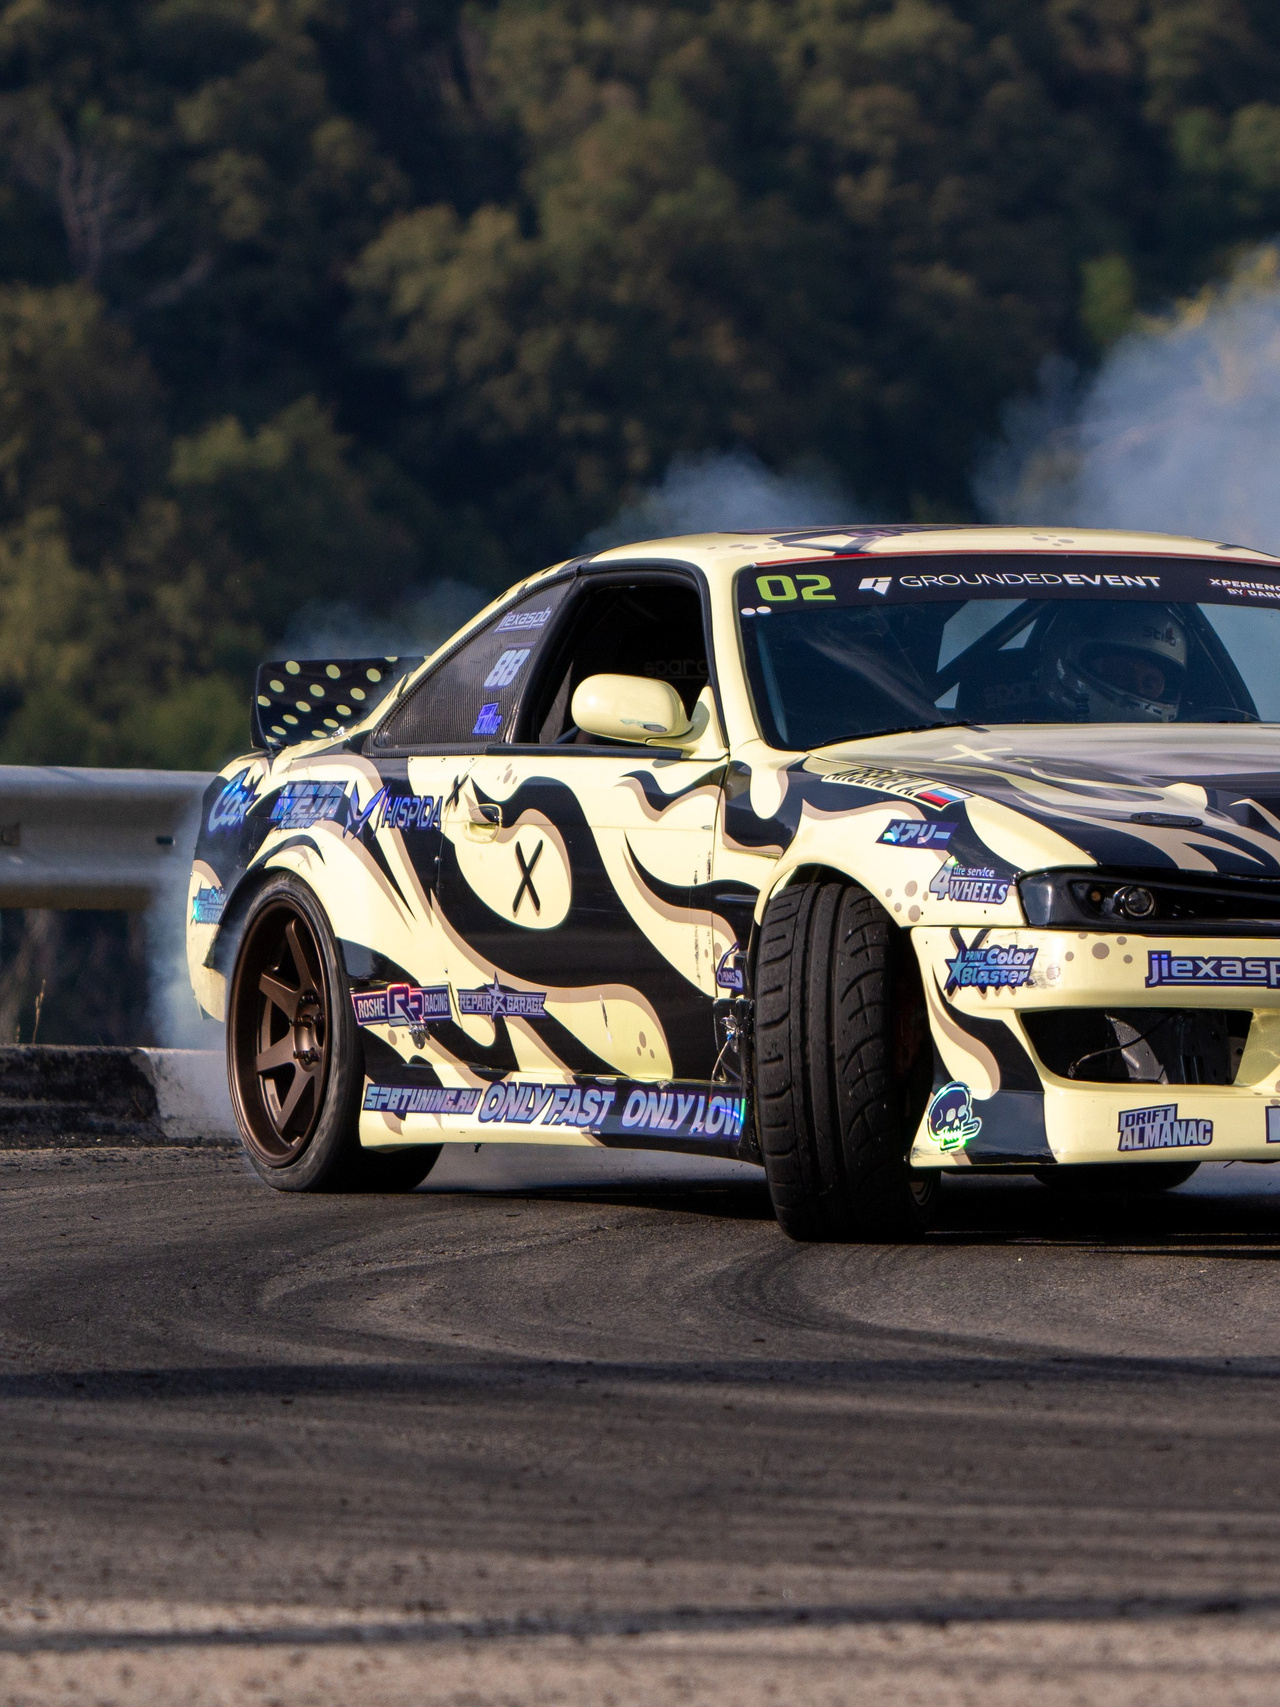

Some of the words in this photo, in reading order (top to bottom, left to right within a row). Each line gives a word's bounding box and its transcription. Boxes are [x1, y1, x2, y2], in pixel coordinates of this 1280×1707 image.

[756, 574, 836, 601] 02
[1227, 588, 1244, 596] BY
[483, 648, 531, 689] 88
[381, 796, 442, 828] HISPIDA
[883, 822, 951, 845] メアリー
[953, 864, 966, 875] tire
[967, 866, 995, 878] service
[949, 880, 1009, 904] WHEELS
[965, 950, 986, 961] PRINT
[986, 948, 1035, 965] Color
[961, 970, 1029, 984] Blaster
[357, 997, 386, 1019] ROSHE
[424, 993, 448, 1013] RACING
[459, 994, 492, 1011] REPAIR
[506, 997, 545, 1013] GARAGE
[478, 1083, 553, 1123] ONLY
[540, 1087, 616, 1127] FAST
[621, 1089, 696, 1131] ONLY
[688, 1095, 746, 1136] LOW
[1125, 1108, 1171, 1127] DRIFT
[1119, 1120, 1212, 1150] ALMANAC
